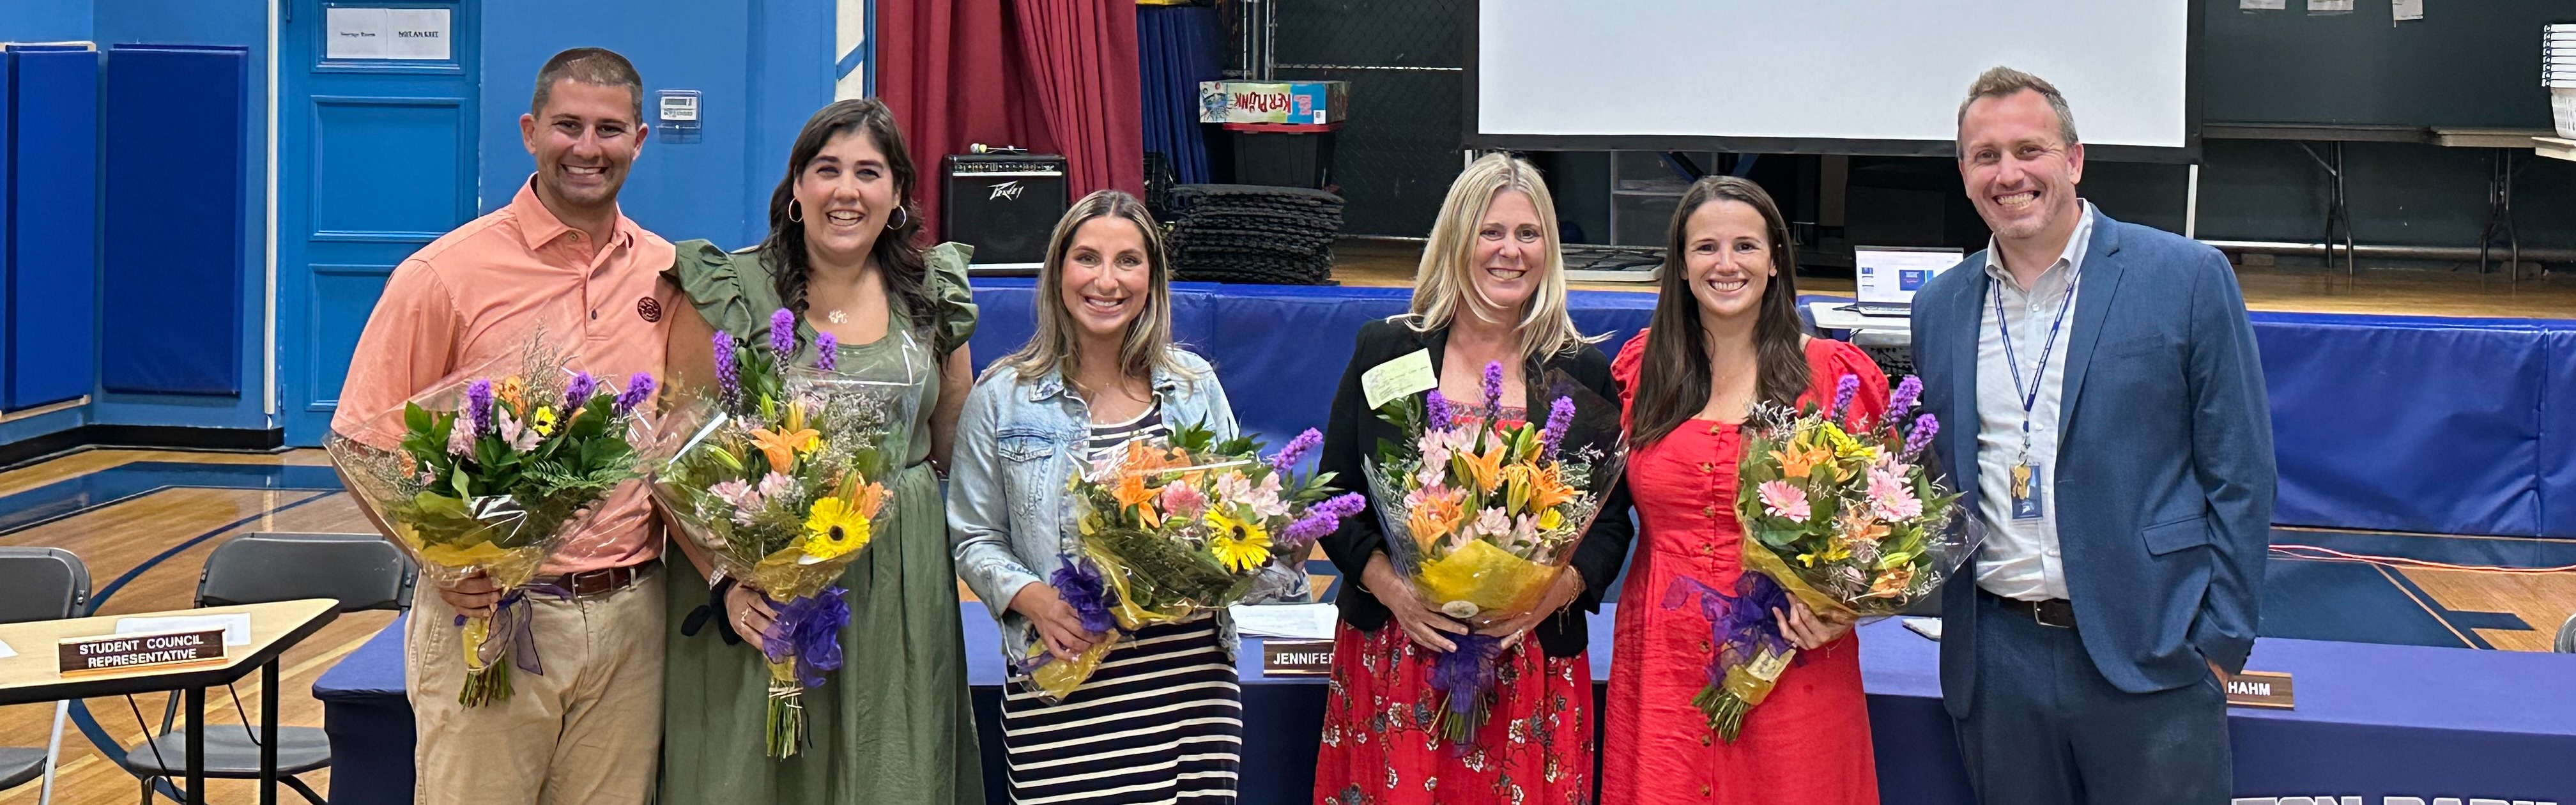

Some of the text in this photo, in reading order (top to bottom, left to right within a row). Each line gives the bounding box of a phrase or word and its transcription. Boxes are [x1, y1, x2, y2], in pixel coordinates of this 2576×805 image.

[79, 635, 203, 656] STUDENT COUNCIL
[88, 649, 197, 668] REPRESENTATIVE
[2228, 681, 2271, 696] HAHM
